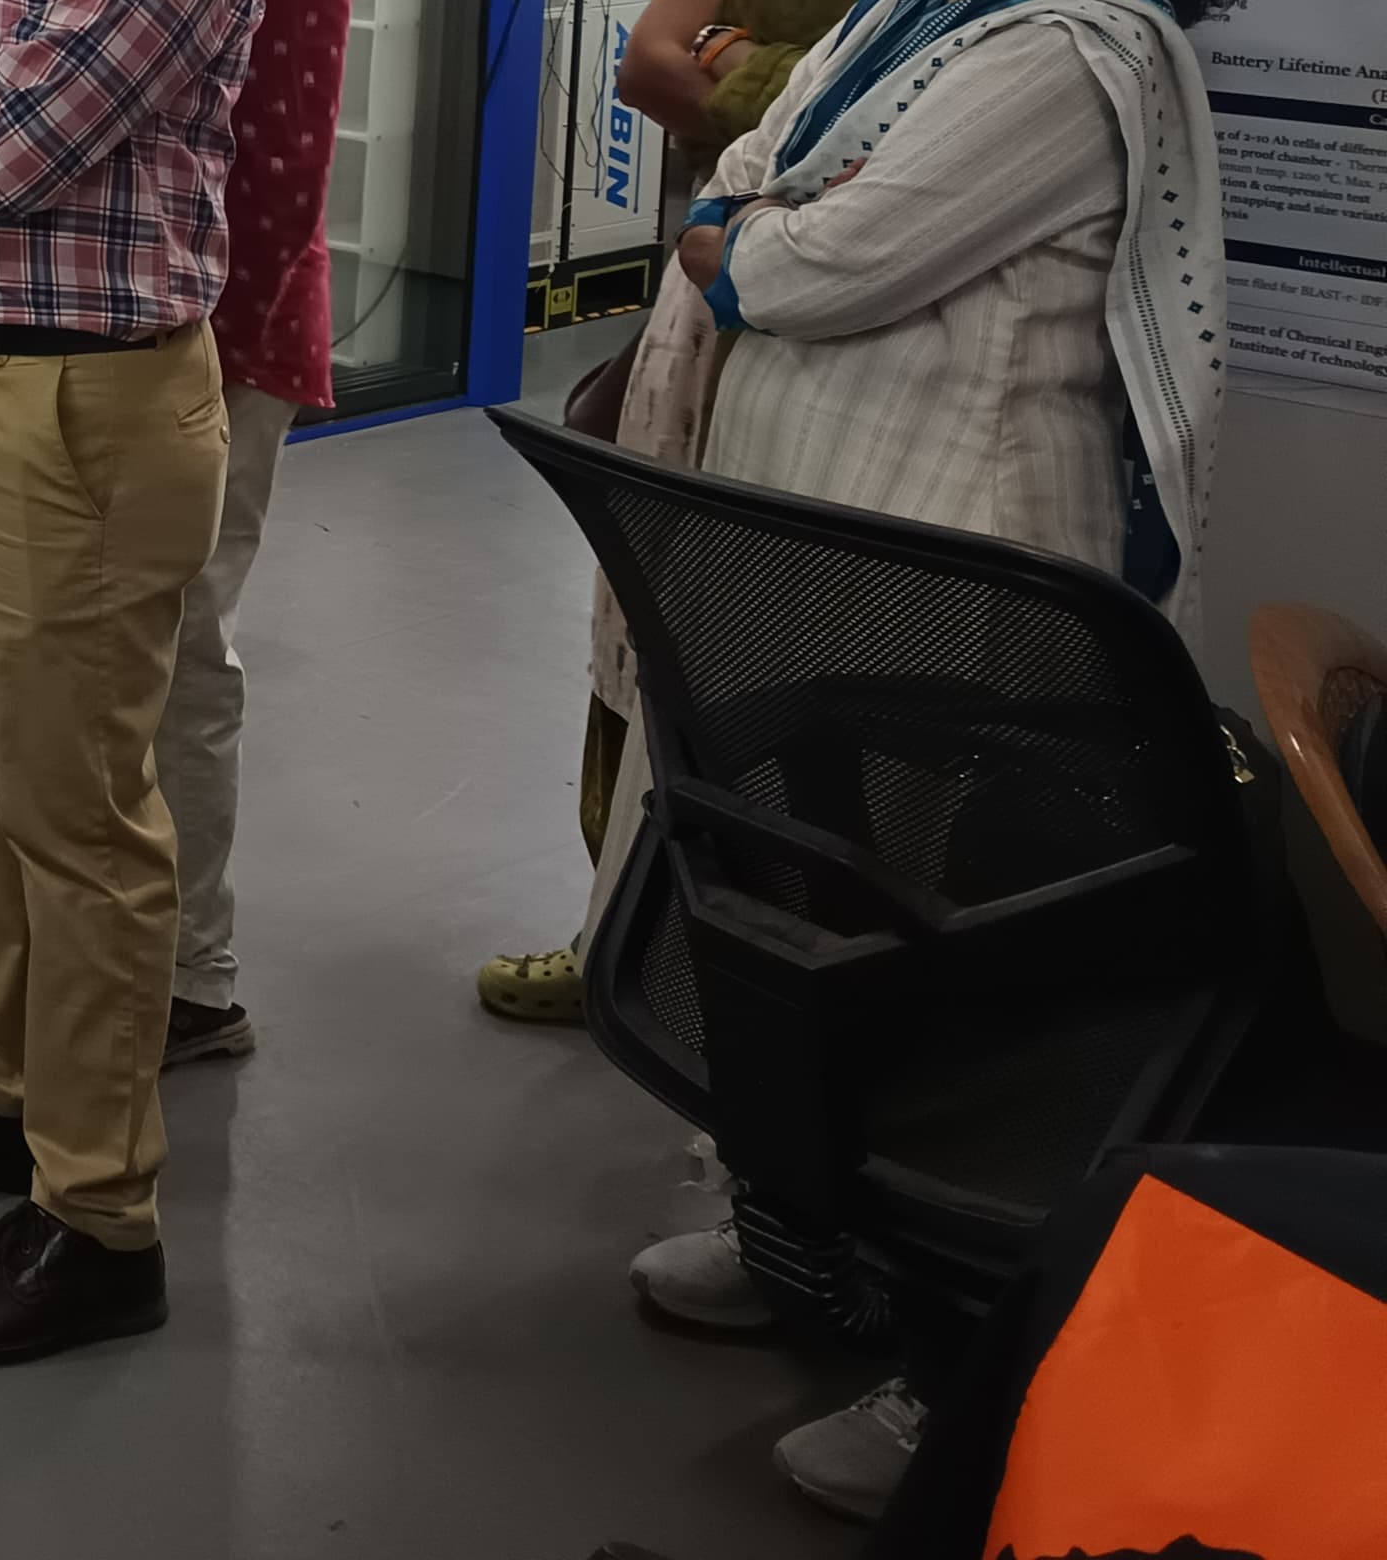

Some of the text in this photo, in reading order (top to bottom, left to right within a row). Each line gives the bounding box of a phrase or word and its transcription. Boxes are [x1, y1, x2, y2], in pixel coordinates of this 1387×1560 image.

[1211, 50, 1273, 72] Battery
[1278, 57, 1351, 77] Lifetime
[606, 20, 632, 209] ABIN
[1227, 130, 1241, 141] of
[1243, 133, 1270, 145] 2-10
[1273, 134, 1290, 146] Ah
[1292, 138, 1321, 150] cells
[1323, 141, 1338, 152] of
[1241, 149, 1275, 163] proof
[1277, 151, 1332, 168] chamber
[1218, 161, 1252, 174] imum
[1254, 164, 1287, 180] temp.
[1291, 172, 1321, 183] 1200
[1344, 174, 1375, 189] Max.
[1249, 180, 1260, 190] &
[1263, 183, 1343, 202] compression
[1346, 192, 1371, 204] test
[1221, 206, 1249, 220] lysis
[1229, 193, 1285, 211] mapping
[1286, 200, 1311, 213] and
[1313, 205, 1339, 217] size
[1298, 255, 1387, 279] Intellectual
[1226, 274, 1250, 287] tent
[1252, 277, 1278, 291] filed
[1280, 282, 1298, 295] for
[1226, 321, 1266, 336] tment
[1269, 326, 1287, 339] of
[1287, 329, 1352, 349] Chemical
[1229, 337, 1288, 357] Institute
[1290, 349, 1308, 361] of
